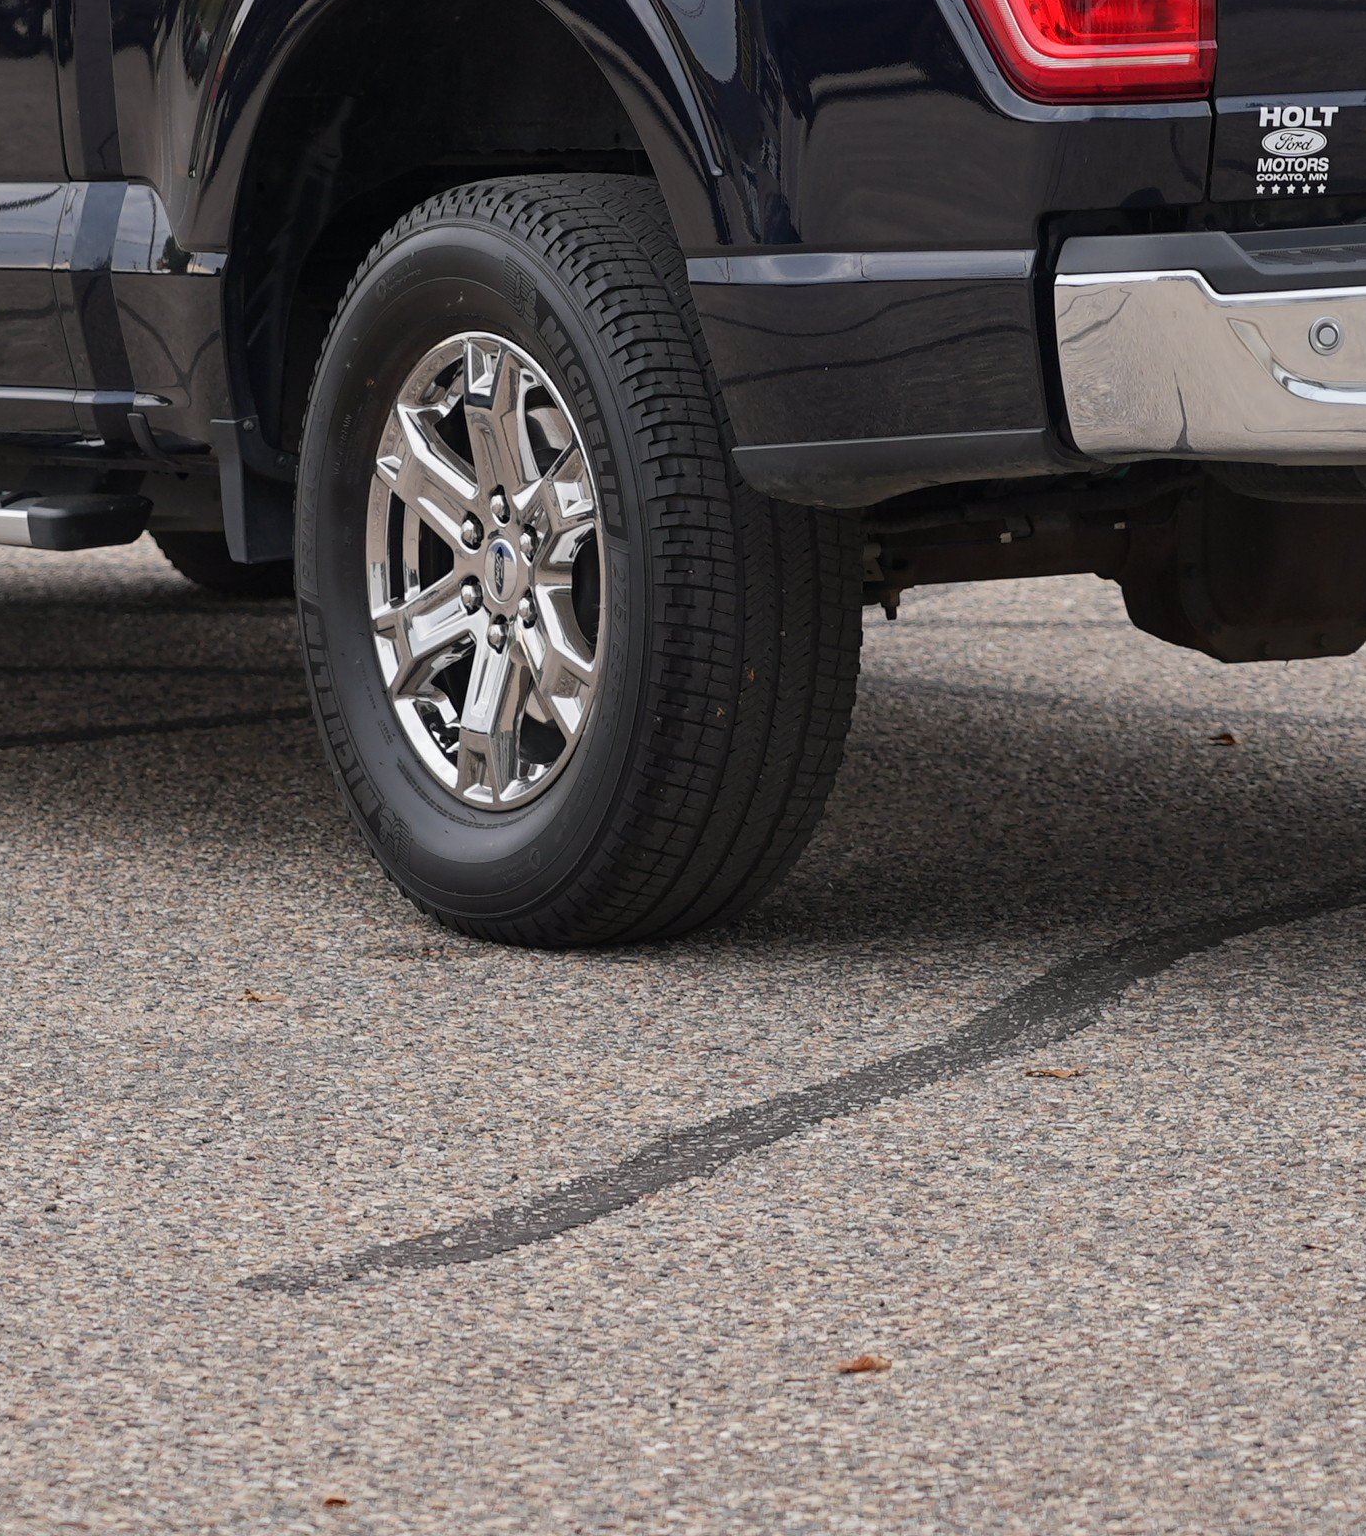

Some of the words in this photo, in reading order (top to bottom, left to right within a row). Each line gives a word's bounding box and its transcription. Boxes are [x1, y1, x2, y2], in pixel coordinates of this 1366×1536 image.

[1259, 106, 1339, 127] HOLT
[1274, 132, 1314, 151] Ford
[1257, 157, 1330, 172] MOTORS
[1256, 173, 1306, 182] COKATO,
[1308, 173, 1328, 181] MN
[539, 315, 624, 529] MICHELIN
[305, 612, 380, 818] MICHELIN
